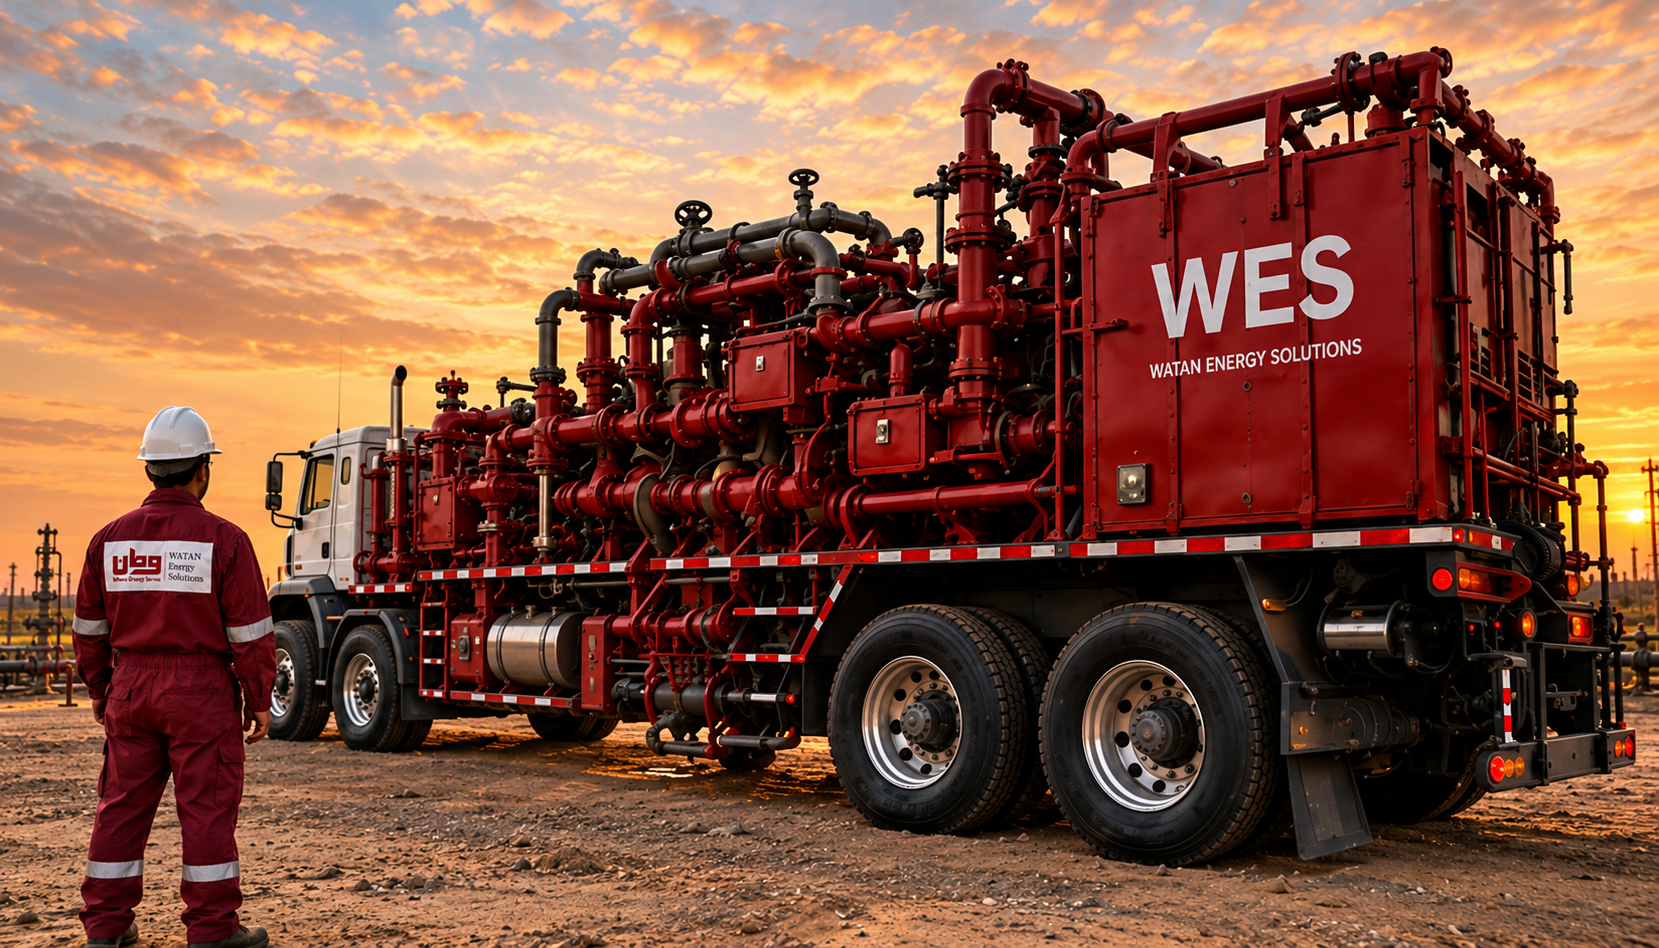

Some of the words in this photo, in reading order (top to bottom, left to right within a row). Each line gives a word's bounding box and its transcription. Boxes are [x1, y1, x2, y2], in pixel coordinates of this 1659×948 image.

[1151, 234, 1354, 339] WES
[1149, 358, 1201, 379] WATAN
[1206, 350, 1266, 373] ENERGY
[1270, 338, 1362, 365] SOLUTIONS
[169, 552, 202, 560] WATAN
[168, 562, 195, 572] Energy
[168, 573, 204, 582] Solutions
